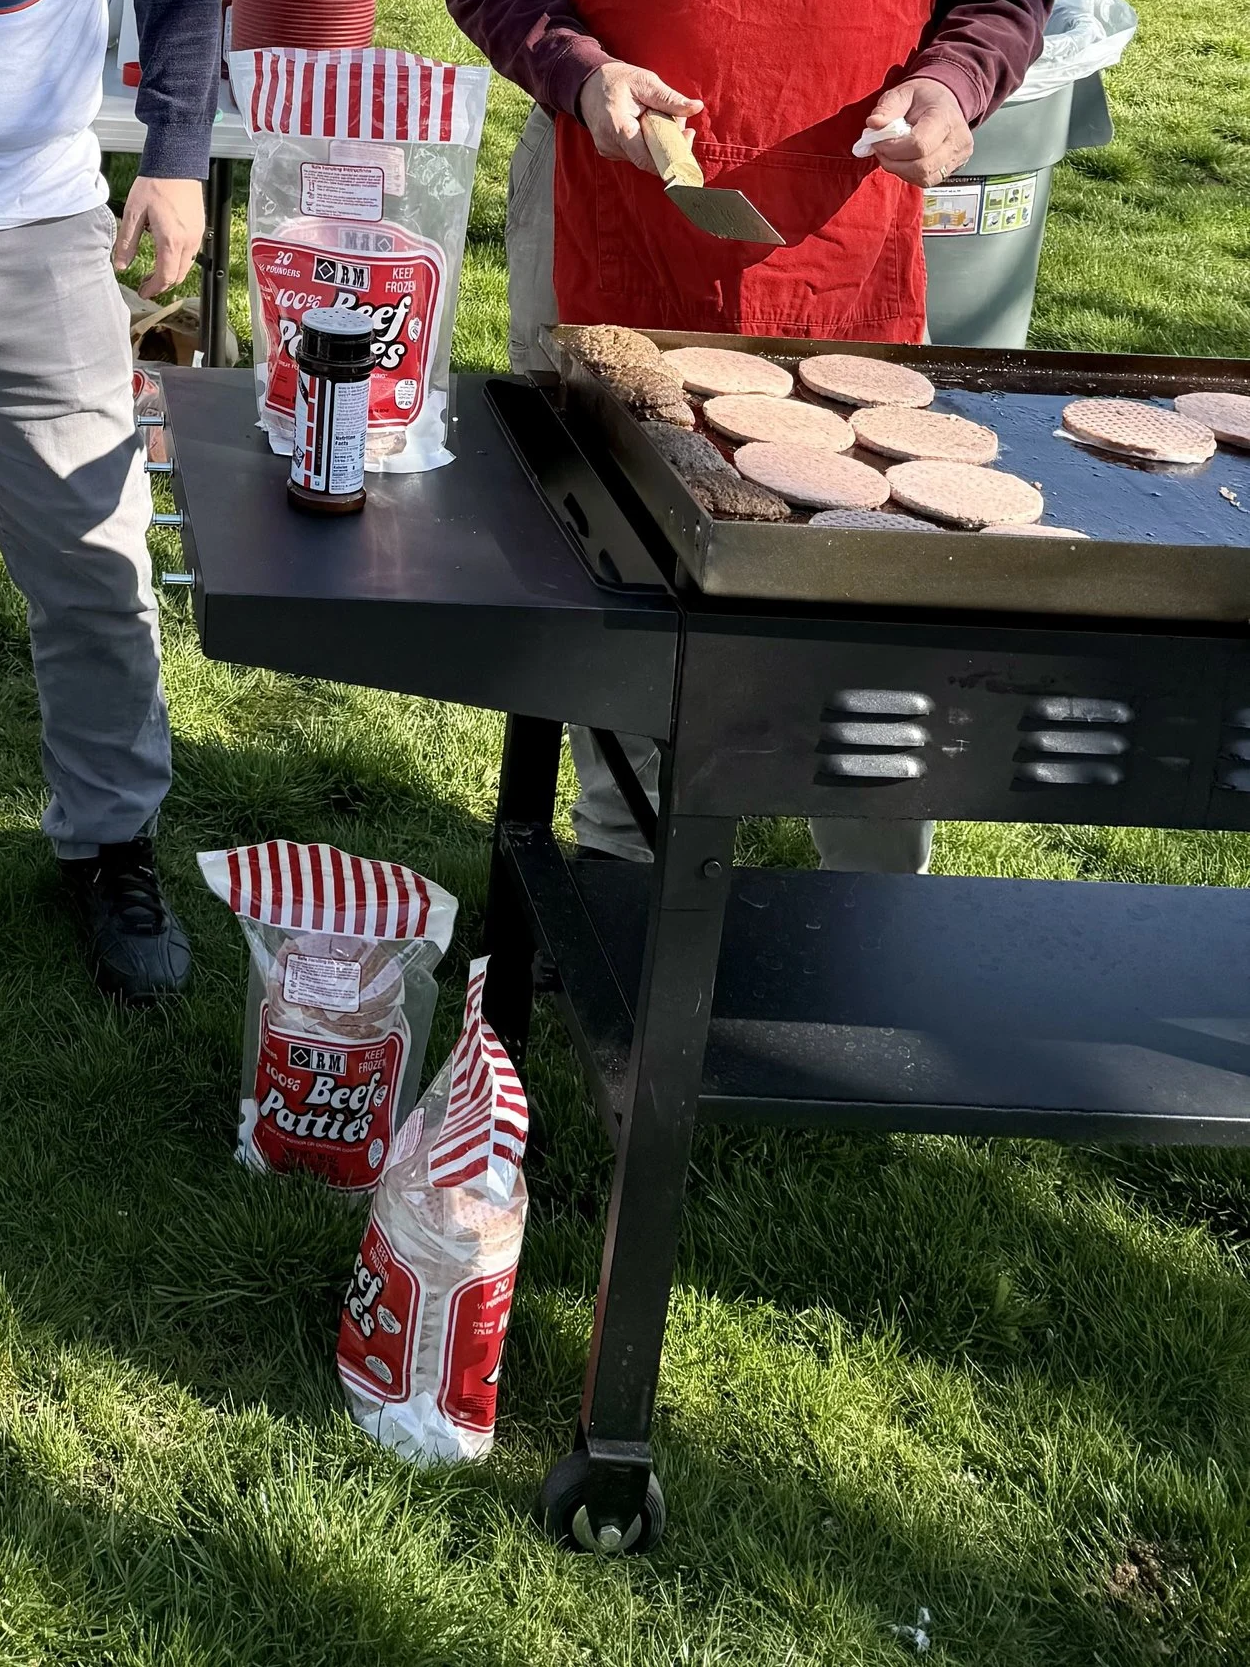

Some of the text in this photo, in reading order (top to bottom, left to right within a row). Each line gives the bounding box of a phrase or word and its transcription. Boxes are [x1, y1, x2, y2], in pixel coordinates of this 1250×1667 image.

[274, 250, 293, 265] 20
[265, 264, 301, 278] POUNDERS
[392, 267, 414, 280] KEEP
[274, 288, 323, 310] 100%
[364, 1047, 385, 1061] KEEP
[358, 1057, 387, 1074] FROZEN
[265, 1062, 381, 1118] 100% Beef
[259, 1087, 373, 1143] Patties
[375, 1240, 389, 1265] KEEP
[369, 1246, 390, 1285] FROZEN
[354, 1252, 383, 1307] eef
[492, 1277, 510, 1297] 20
